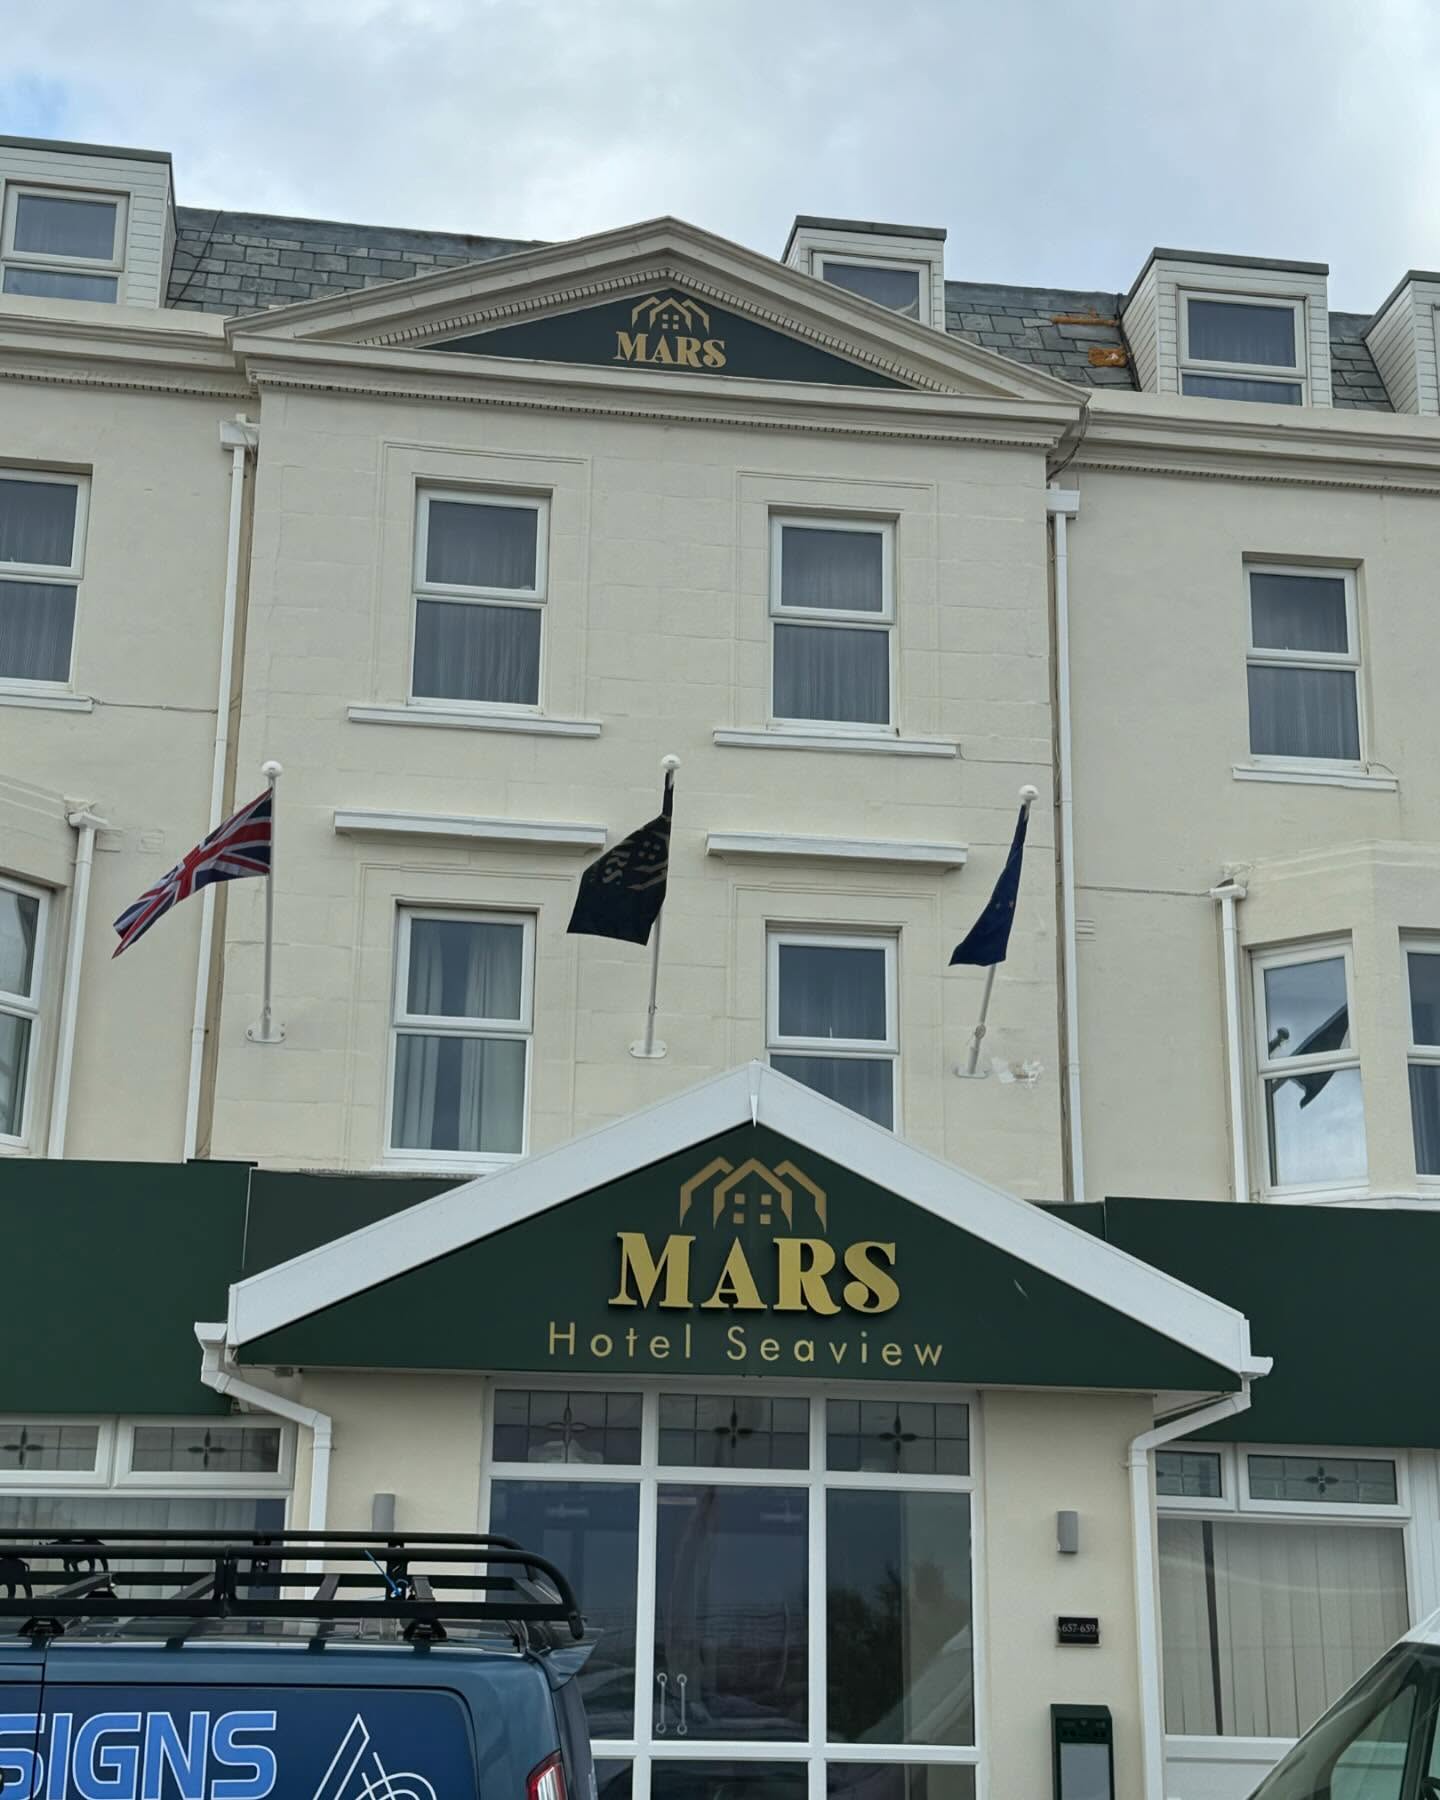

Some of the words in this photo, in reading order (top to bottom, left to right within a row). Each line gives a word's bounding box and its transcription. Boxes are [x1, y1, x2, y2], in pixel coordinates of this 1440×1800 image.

[612, 331, 727, 368] MARS
[608, 1231, 900, 1315] MARS
[548, 1321, 691, 1359] Hotel
[726, 1325, 943, 1367] Seaview
[0, 1710, 277, 1800] SIGNS
